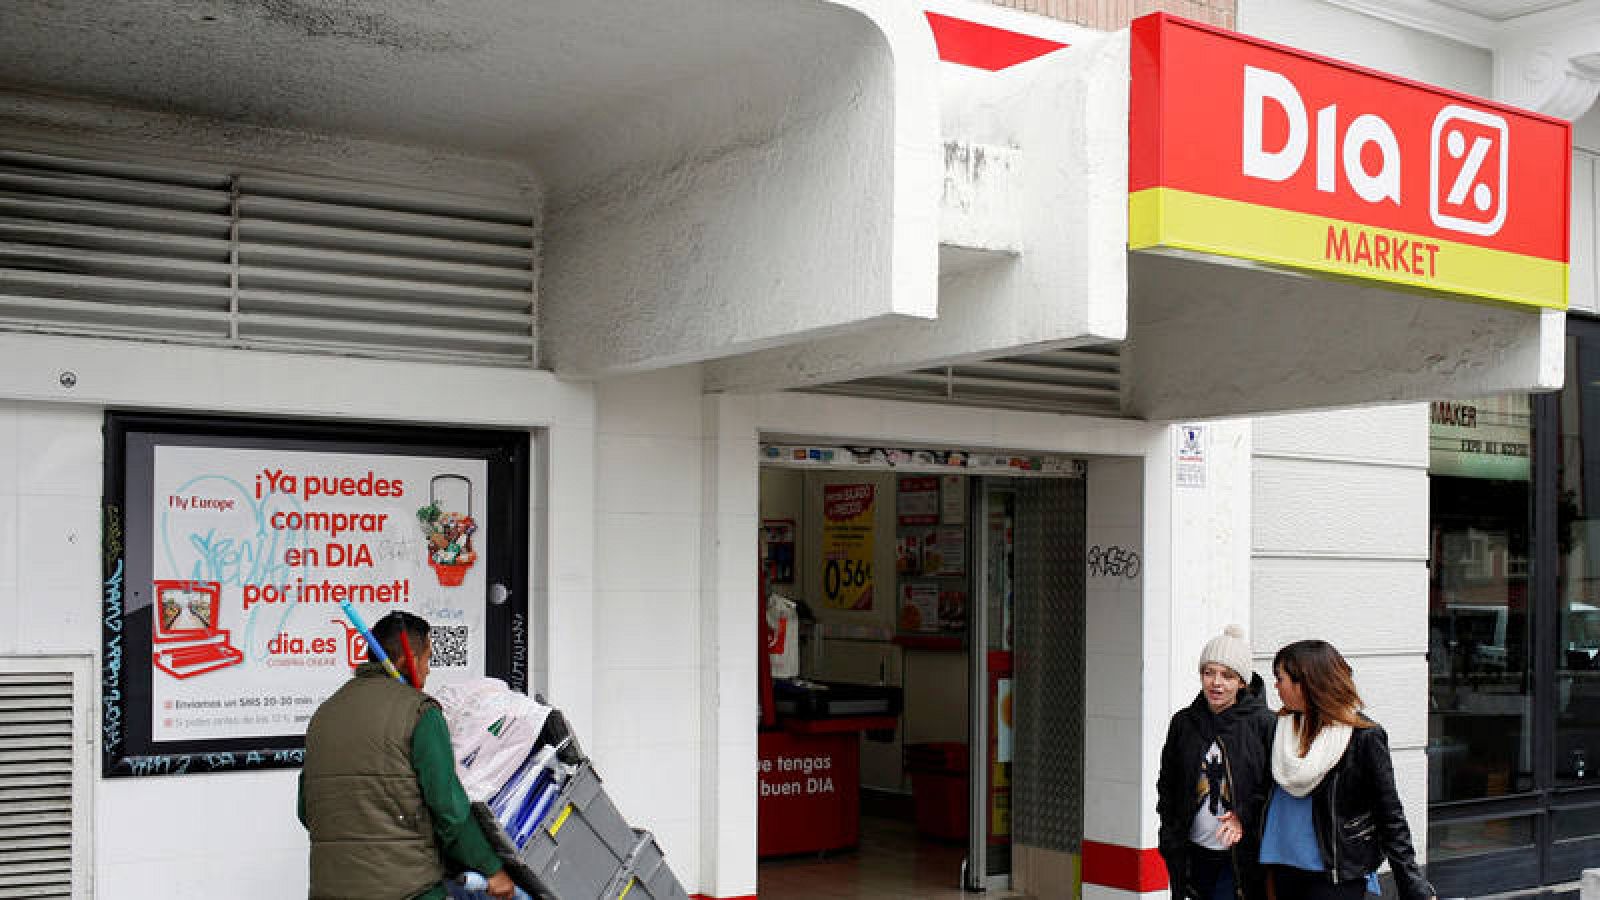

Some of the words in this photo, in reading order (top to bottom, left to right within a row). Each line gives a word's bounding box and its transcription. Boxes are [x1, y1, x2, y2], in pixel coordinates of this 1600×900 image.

[1325, 225, 1440, 278] MARKET
[255, 468, 297, 499] ¡Ya
[303, 470, 404, 502] puedes
[168, 495, 189, 510] Fly
[191, 495, 235, 512] Europe
[271, 511, 388, 538] comprar
[284, 547, 319, 567] en
[325, 543, 374, 567] DIA
[243, 583, 291, 609] por
[297, 578, 409, 602] internet!
[267, 632, 337, 655] dia.es
[239, 697, 261, 707] SMS
[777, 755, 832, 775] tengas
[761, 781, 801, 796] buen
[807, 777, 834, 794] DIA
